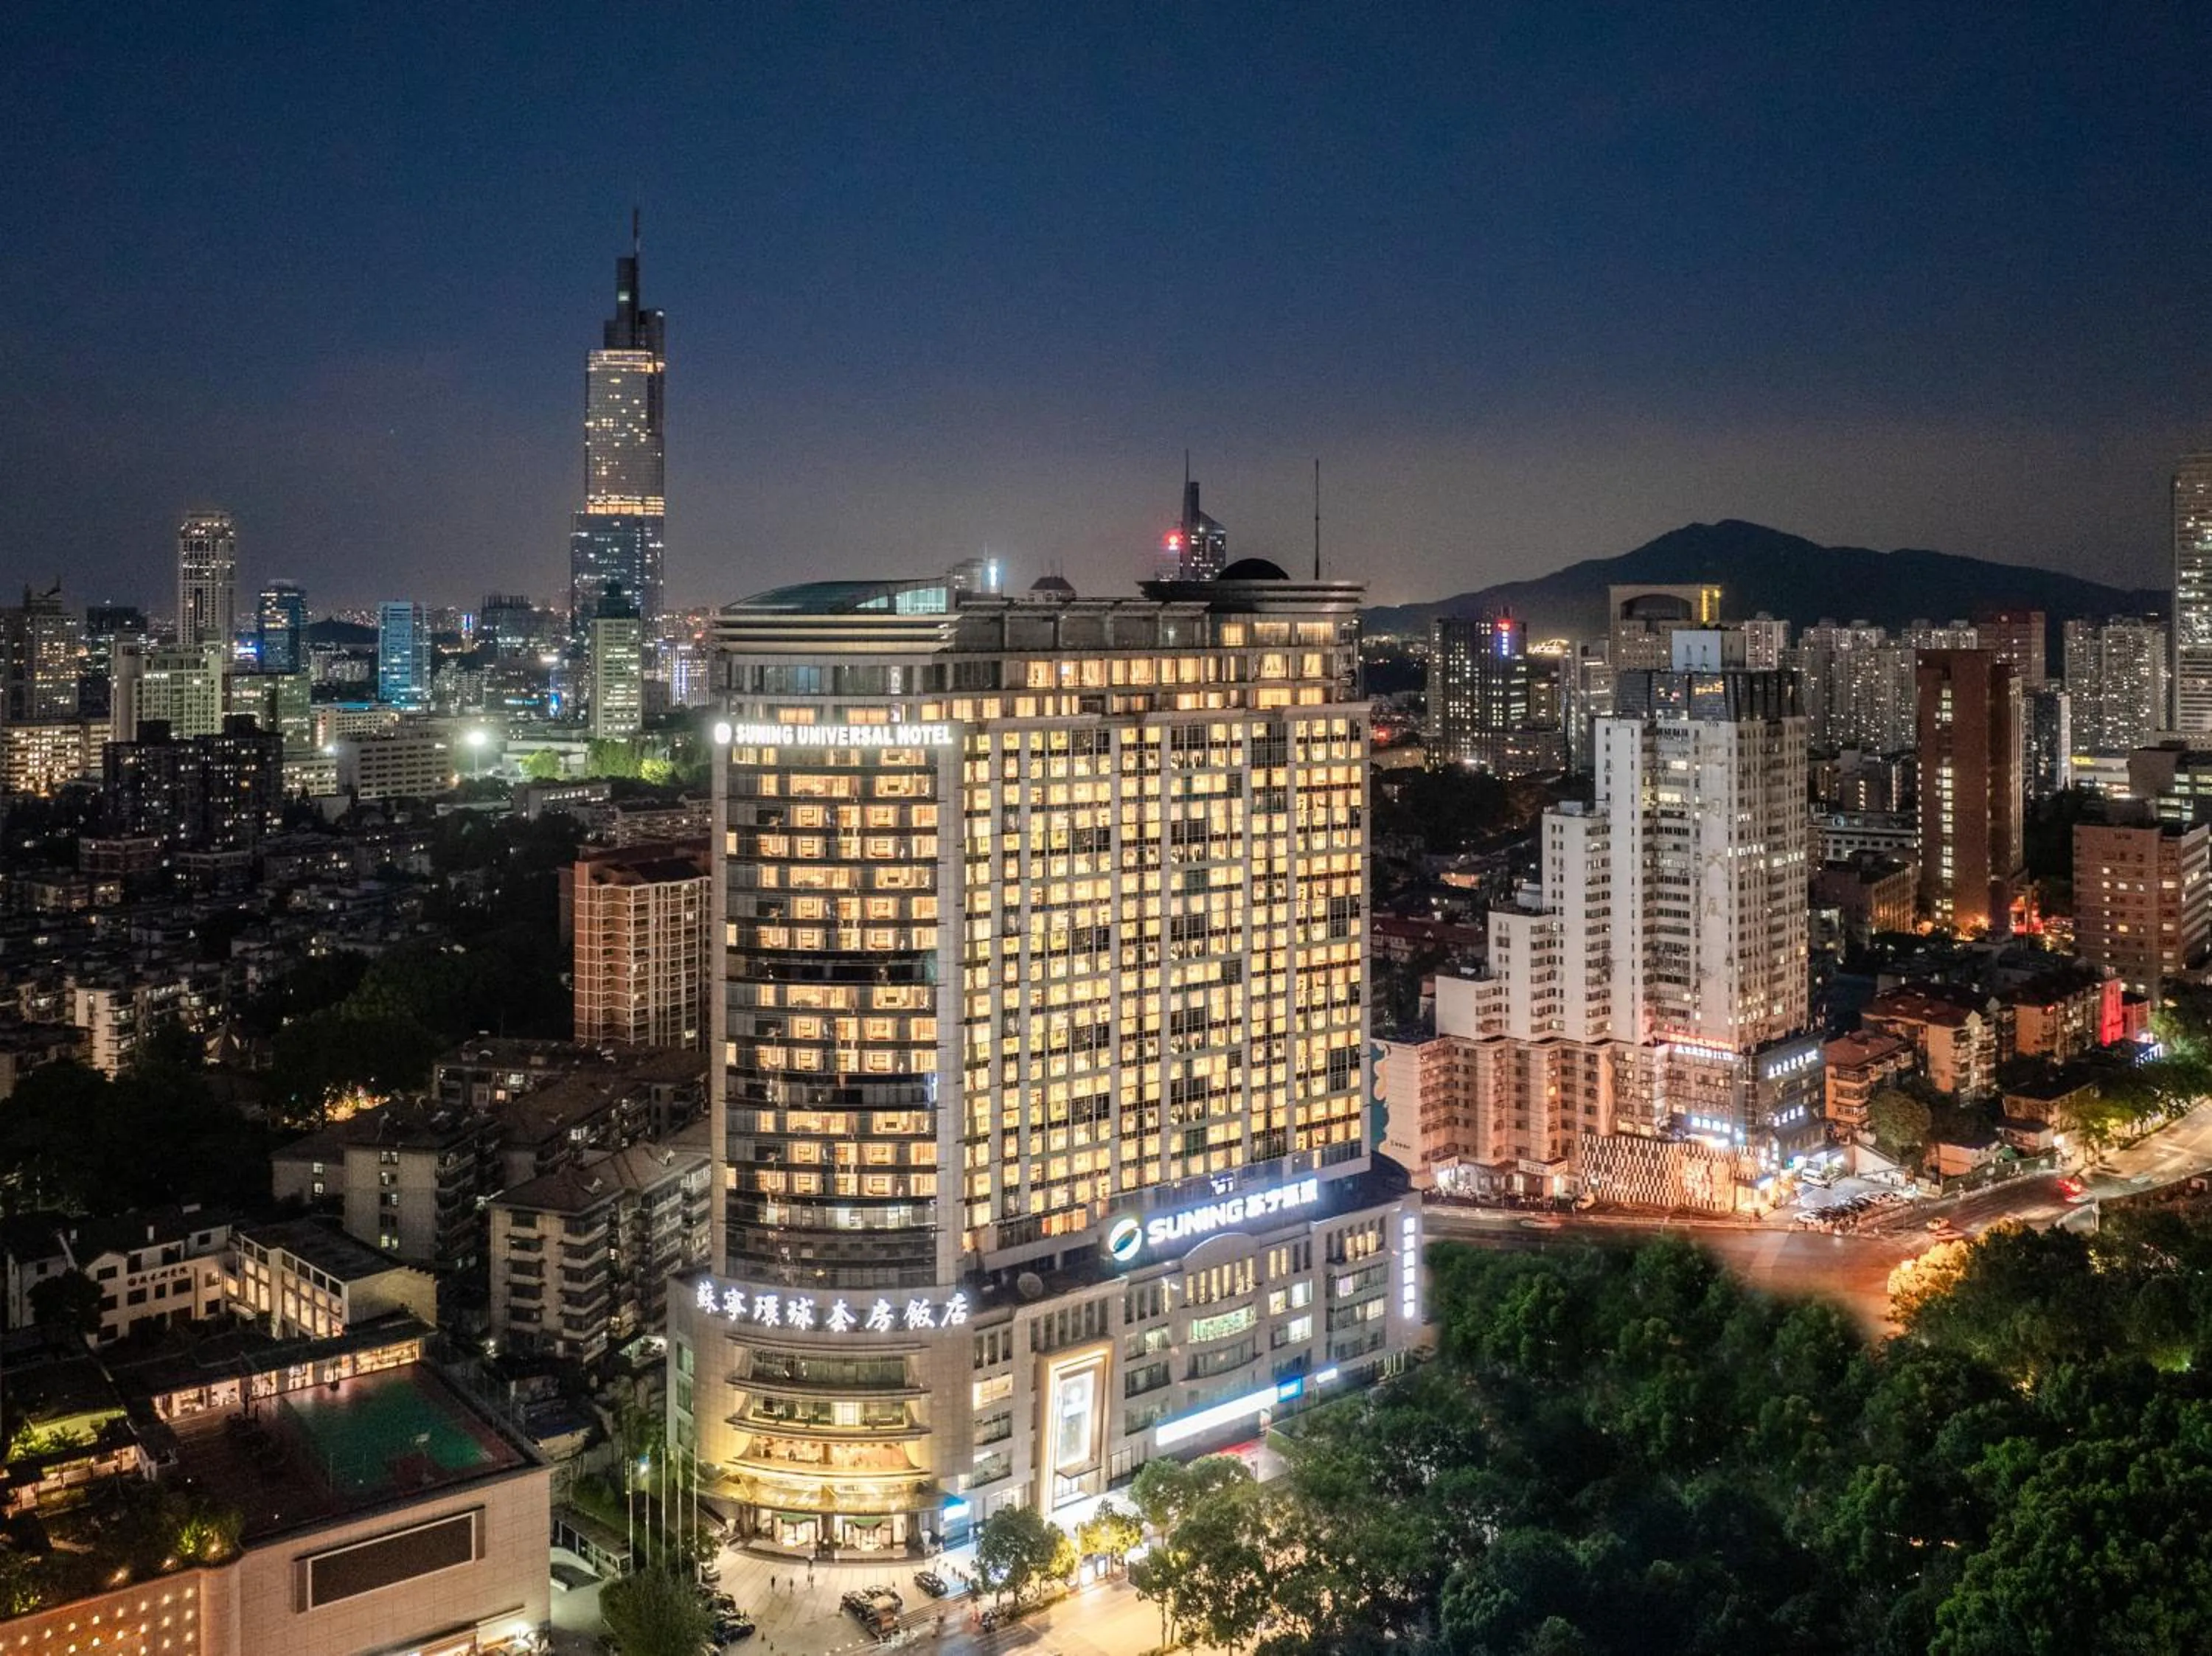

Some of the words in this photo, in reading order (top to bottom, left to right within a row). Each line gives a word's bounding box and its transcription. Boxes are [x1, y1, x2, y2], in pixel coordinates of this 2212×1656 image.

[736, 724, 793, 745] SUNING
[797, 725, 894, 745] UNIVERSAL
[897, 726, 953, 745] HOTEL
[1147, 1198, 1244, 1246] SUNING
